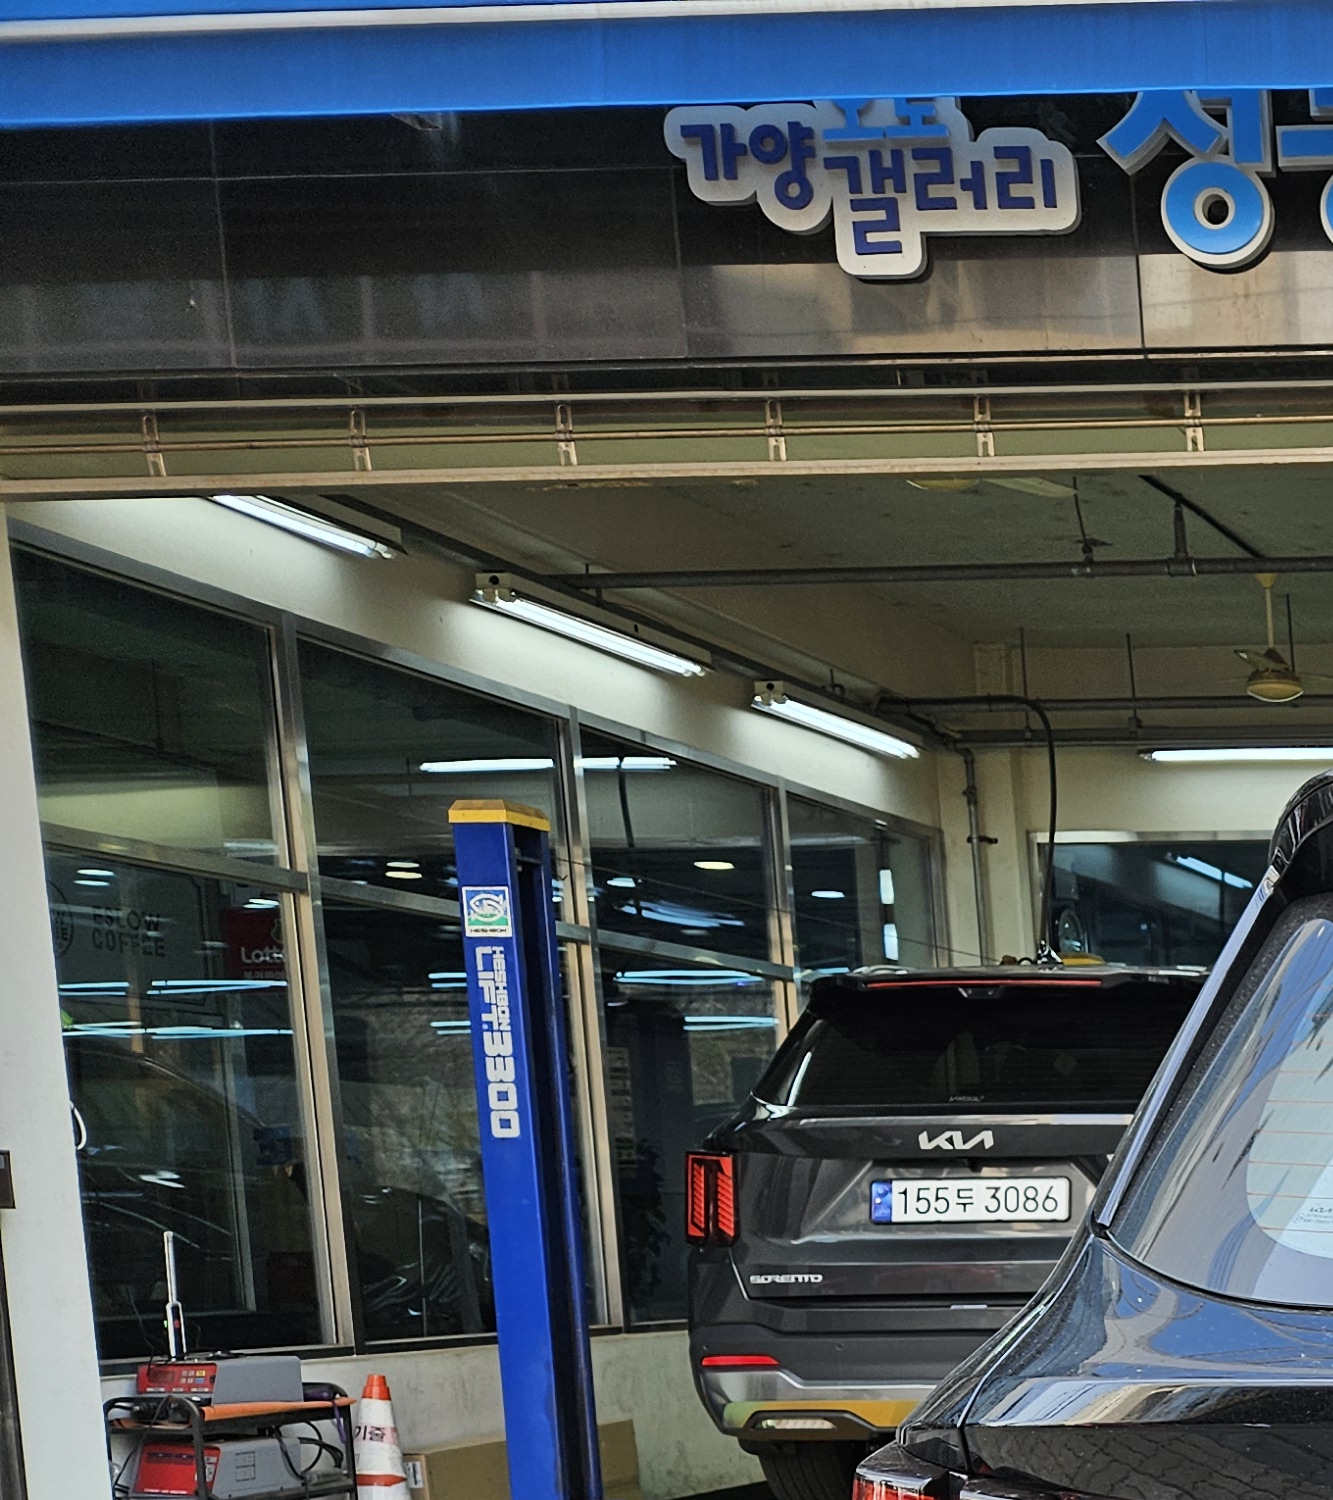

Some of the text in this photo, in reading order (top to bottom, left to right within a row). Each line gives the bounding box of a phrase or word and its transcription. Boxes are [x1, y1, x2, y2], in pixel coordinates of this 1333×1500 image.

[680, 121, 1058, 256] 가양 갤러리
[491, 945, 512, 1031] HESHBON
[898, 1187, 974, 1215] 155두
[985, 1186, 1058, 1213] 3086
